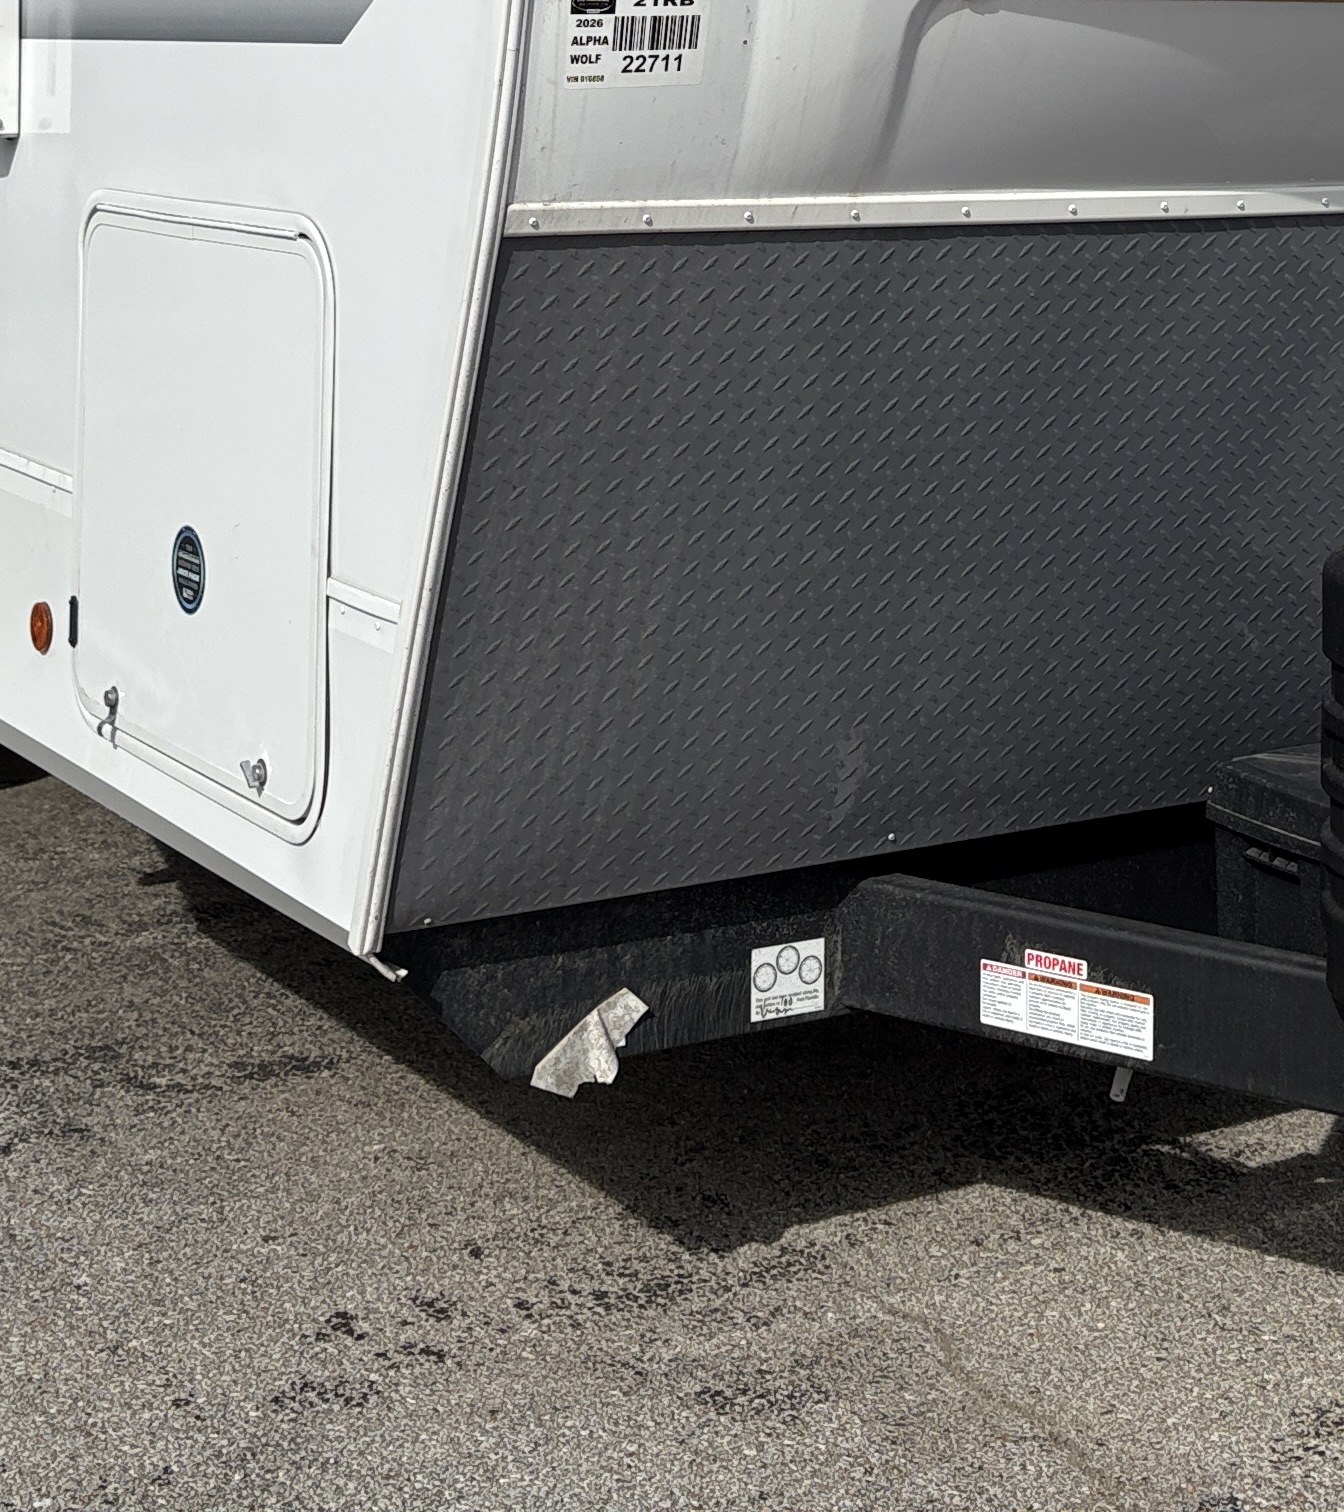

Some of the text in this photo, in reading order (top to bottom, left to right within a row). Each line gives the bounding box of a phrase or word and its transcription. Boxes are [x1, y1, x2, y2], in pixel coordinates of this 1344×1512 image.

[575, 18, 604, 28] 2026
[570, 35, 610, 47] ALPHA
[569, 53, 603, 65] WOLF
[620, 53, 684, 74] 22711
[1026, 952, 1085, 977] PROPANE
